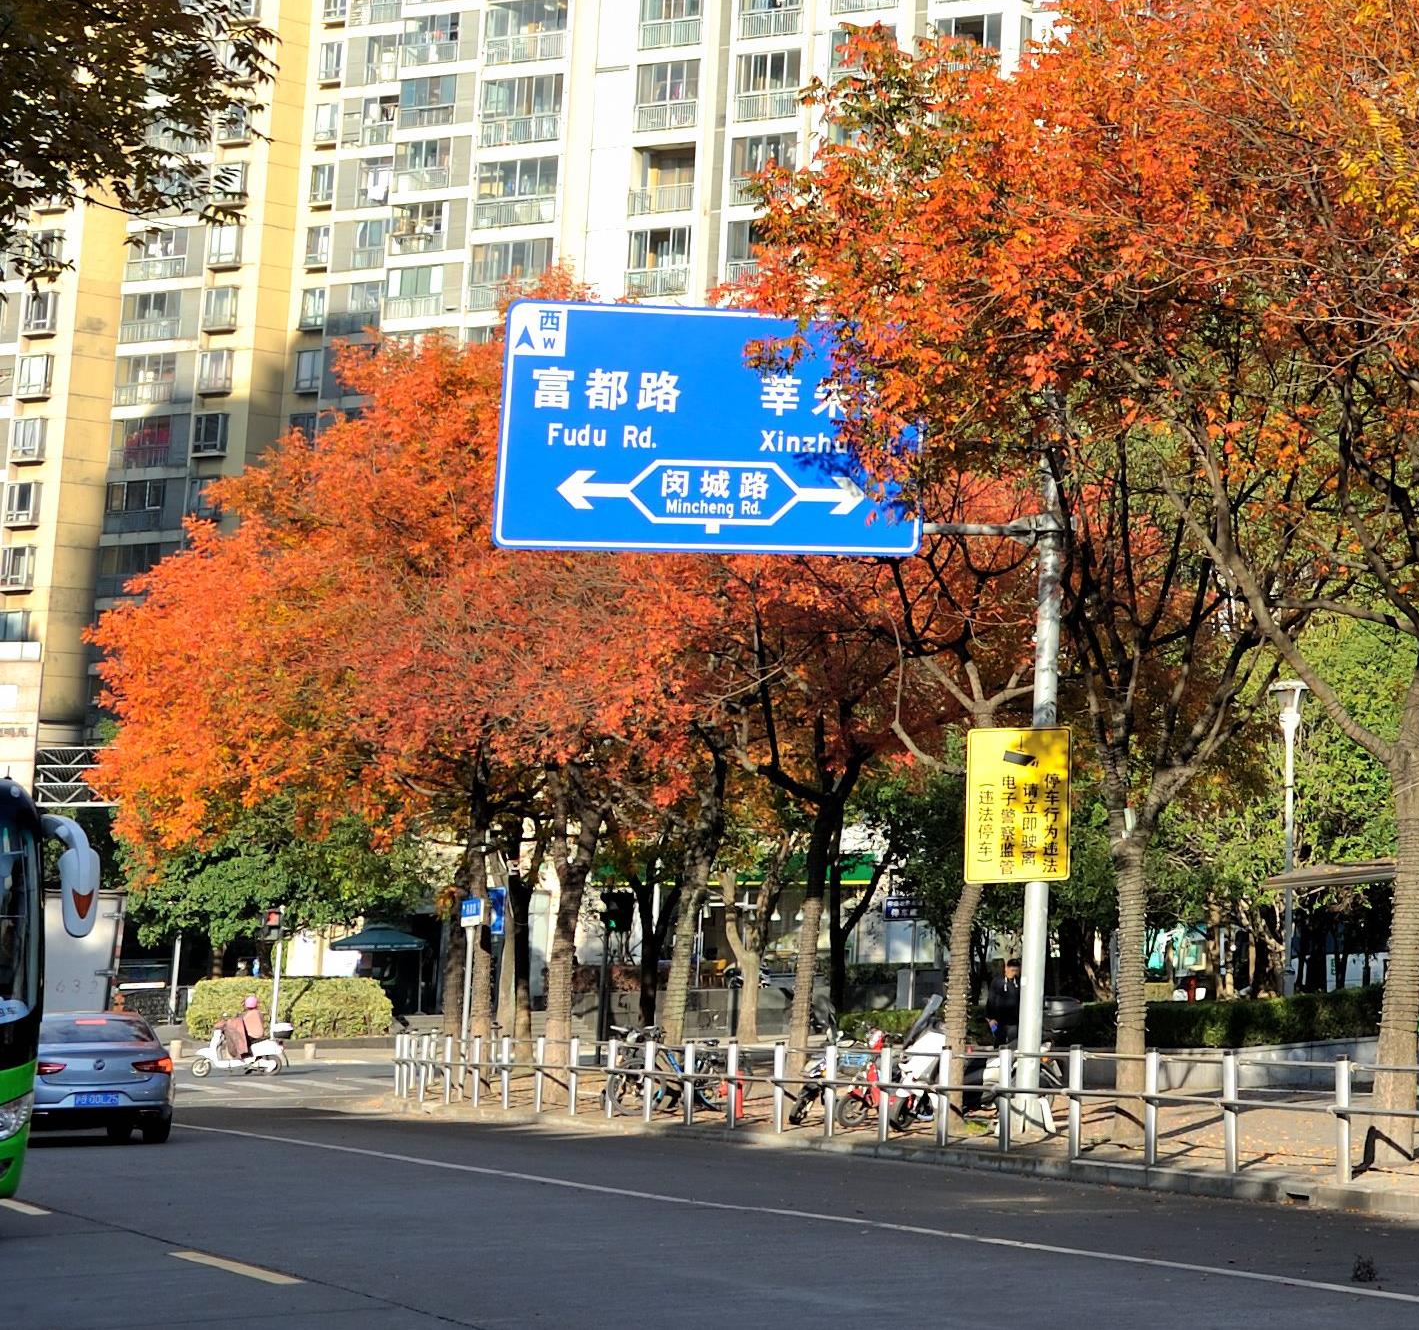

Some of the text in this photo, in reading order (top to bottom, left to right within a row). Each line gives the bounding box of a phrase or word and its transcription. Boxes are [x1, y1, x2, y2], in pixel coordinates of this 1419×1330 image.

[539, 309, 562, 332] 西
[543, 337, 556, 350] W
[532, 366, 682, 413] 富都路
[760, 374, 878, 419] 莘朱
[547, 422, 657, 449] Fudu Rd.
[661, 469, 769, 501] 闵城路
[666, 499, 762, 519] Mincheng Rd.
[1000, 775, 1017, 875] 电子警察监管
[1021, 783, 1039, 866] 请立即驶离
[1043, 774, 1060, 873] 停车行为违法
